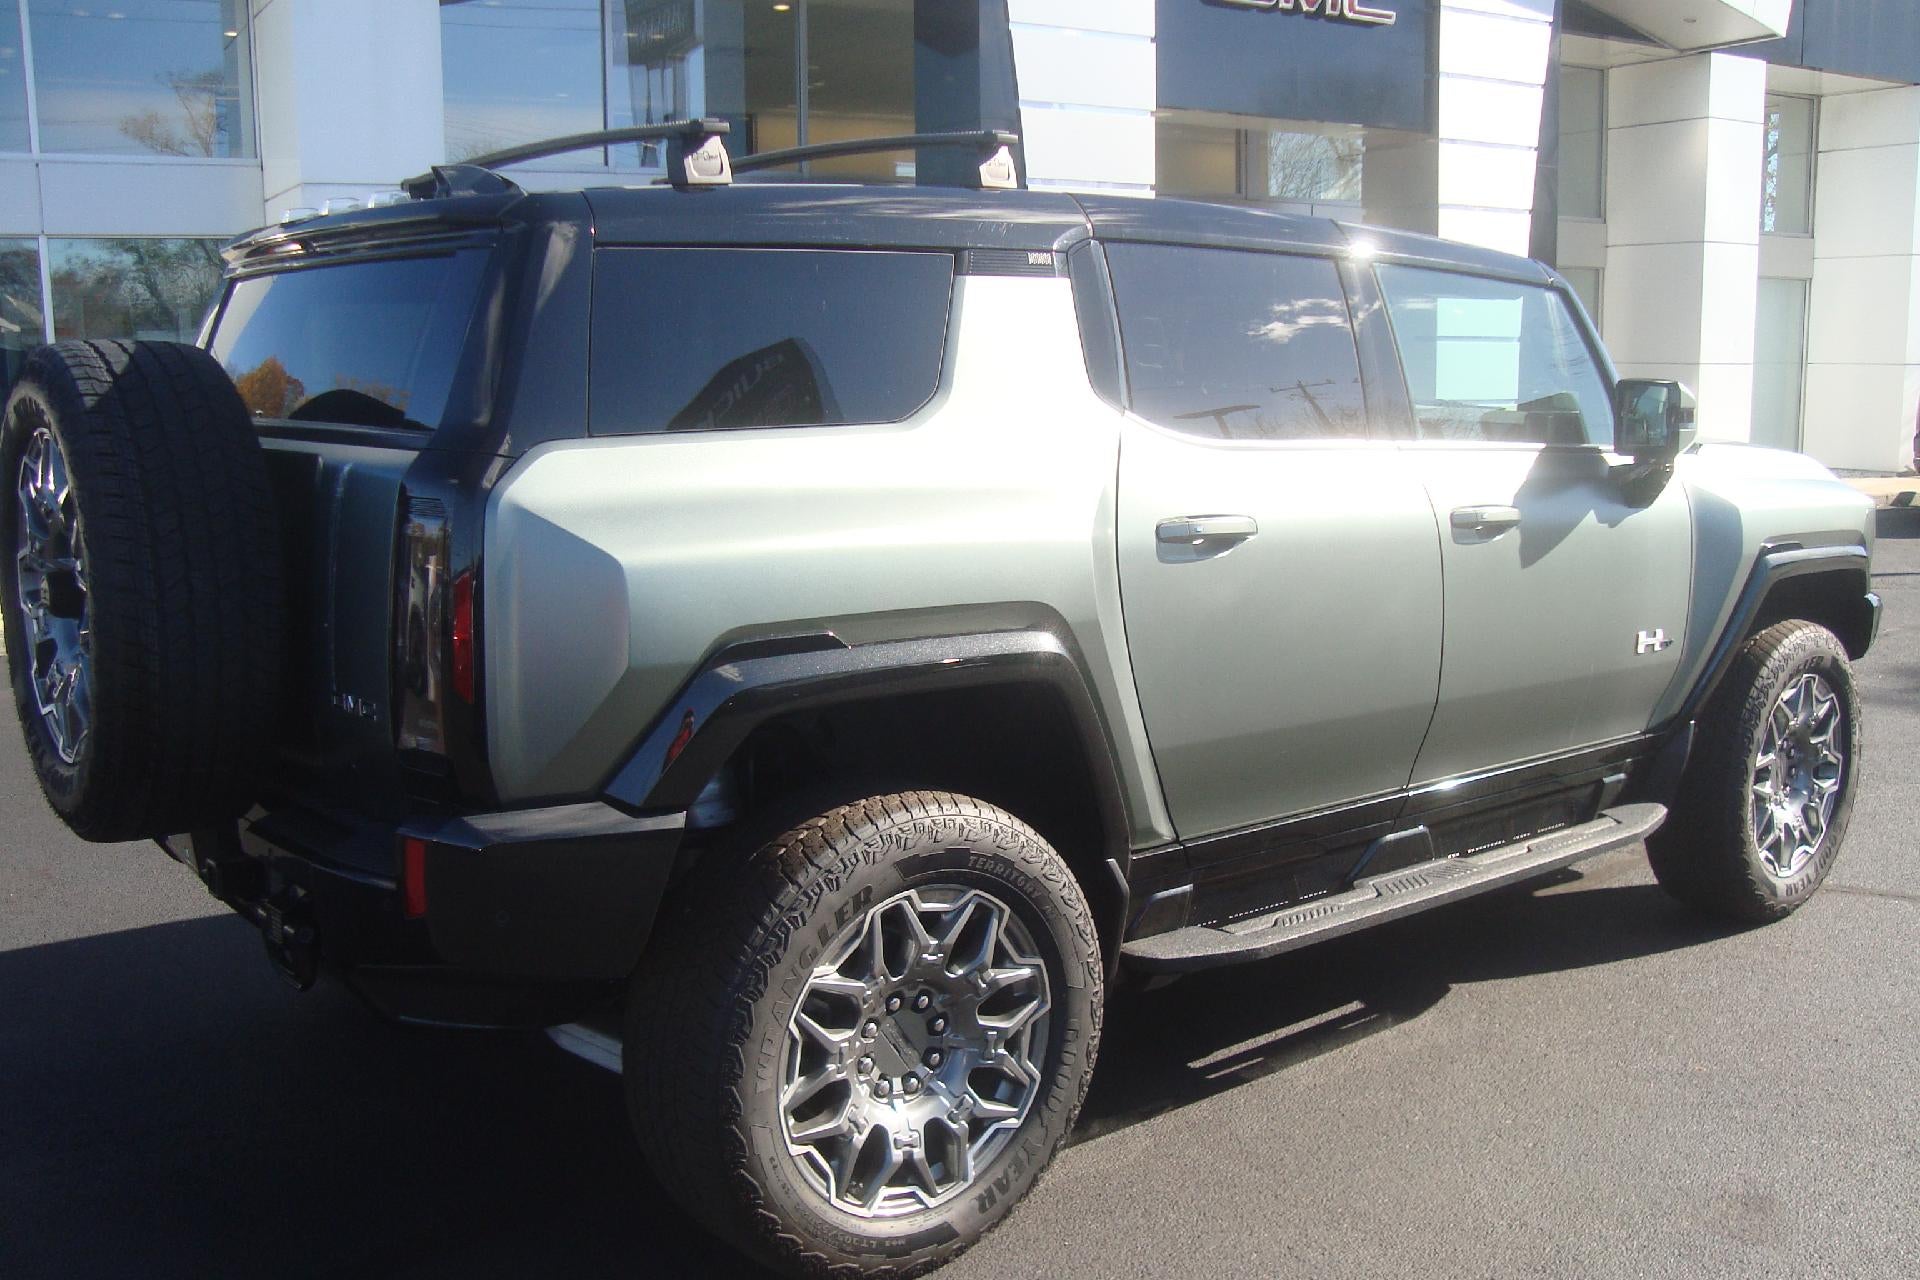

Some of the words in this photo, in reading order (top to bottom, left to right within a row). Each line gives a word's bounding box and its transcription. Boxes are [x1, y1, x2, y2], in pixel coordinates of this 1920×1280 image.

[968, 855, 1042, 899] TERRITORY
[753, 884, 873, 1095] WRANGLER
[975, 1017, 1080, 1214] GOODYEAR
